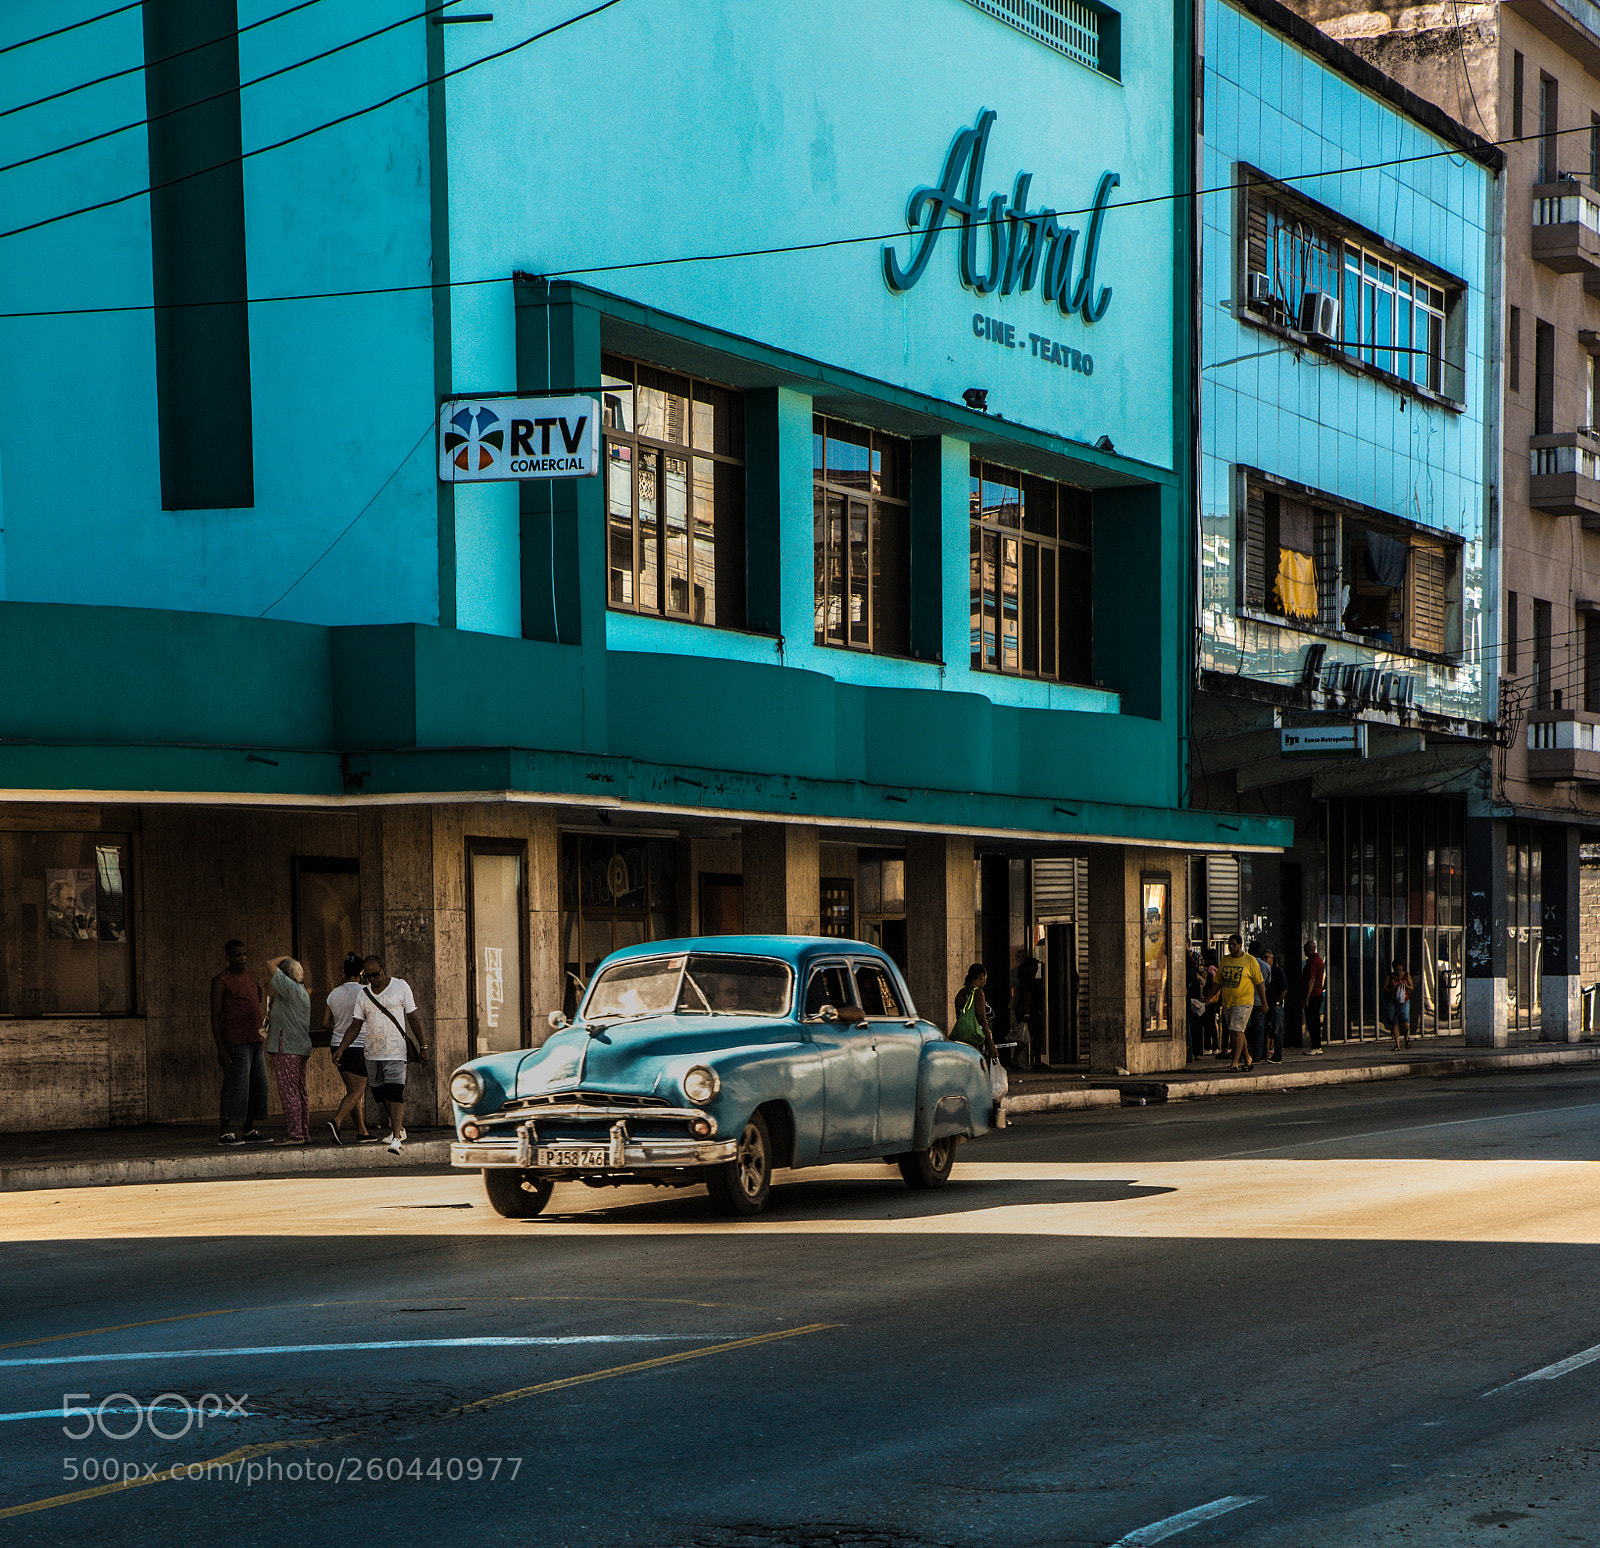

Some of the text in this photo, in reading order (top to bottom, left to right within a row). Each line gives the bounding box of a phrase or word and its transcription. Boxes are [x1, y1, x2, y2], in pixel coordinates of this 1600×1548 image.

[880, 106, 1121, 325] Astral
[972, 313, 1016, 349] CINE
[1028, 332, 1094, 376] TEATRO
[511, 416, 588, 457] RTV
[511, 457, 585, 473] COMERCIAL
